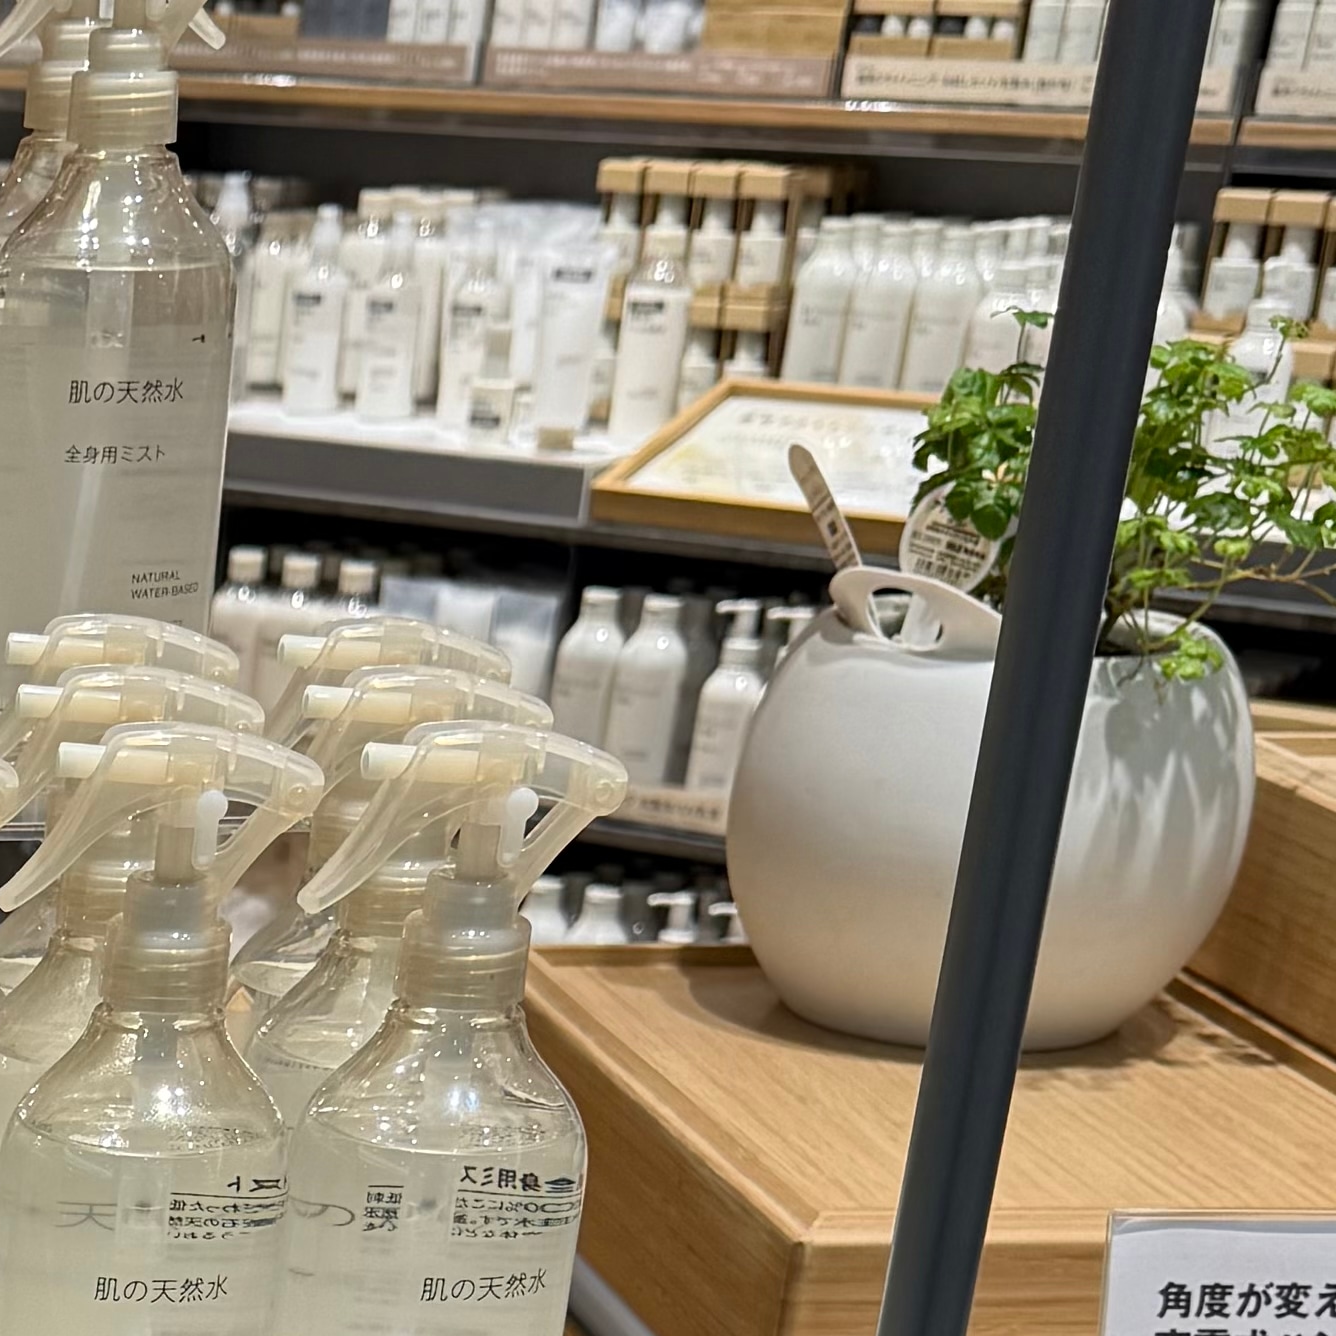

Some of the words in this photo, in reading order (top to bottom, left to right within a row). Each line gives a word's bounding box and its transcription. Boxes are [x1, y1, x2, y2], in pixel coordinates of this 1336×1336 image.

[69, 377, 184, 404] 肌の天然水
[64, 444, 166, 464] 全身用ミスト
[131, 570, 181, 584] NATURAL
[94, 1274, 229, 1304] 肌の天然水
[420, 1268, 547, 1302] 肌の天然水
[1156, 1281, 1336, 1319] 角度が変え
